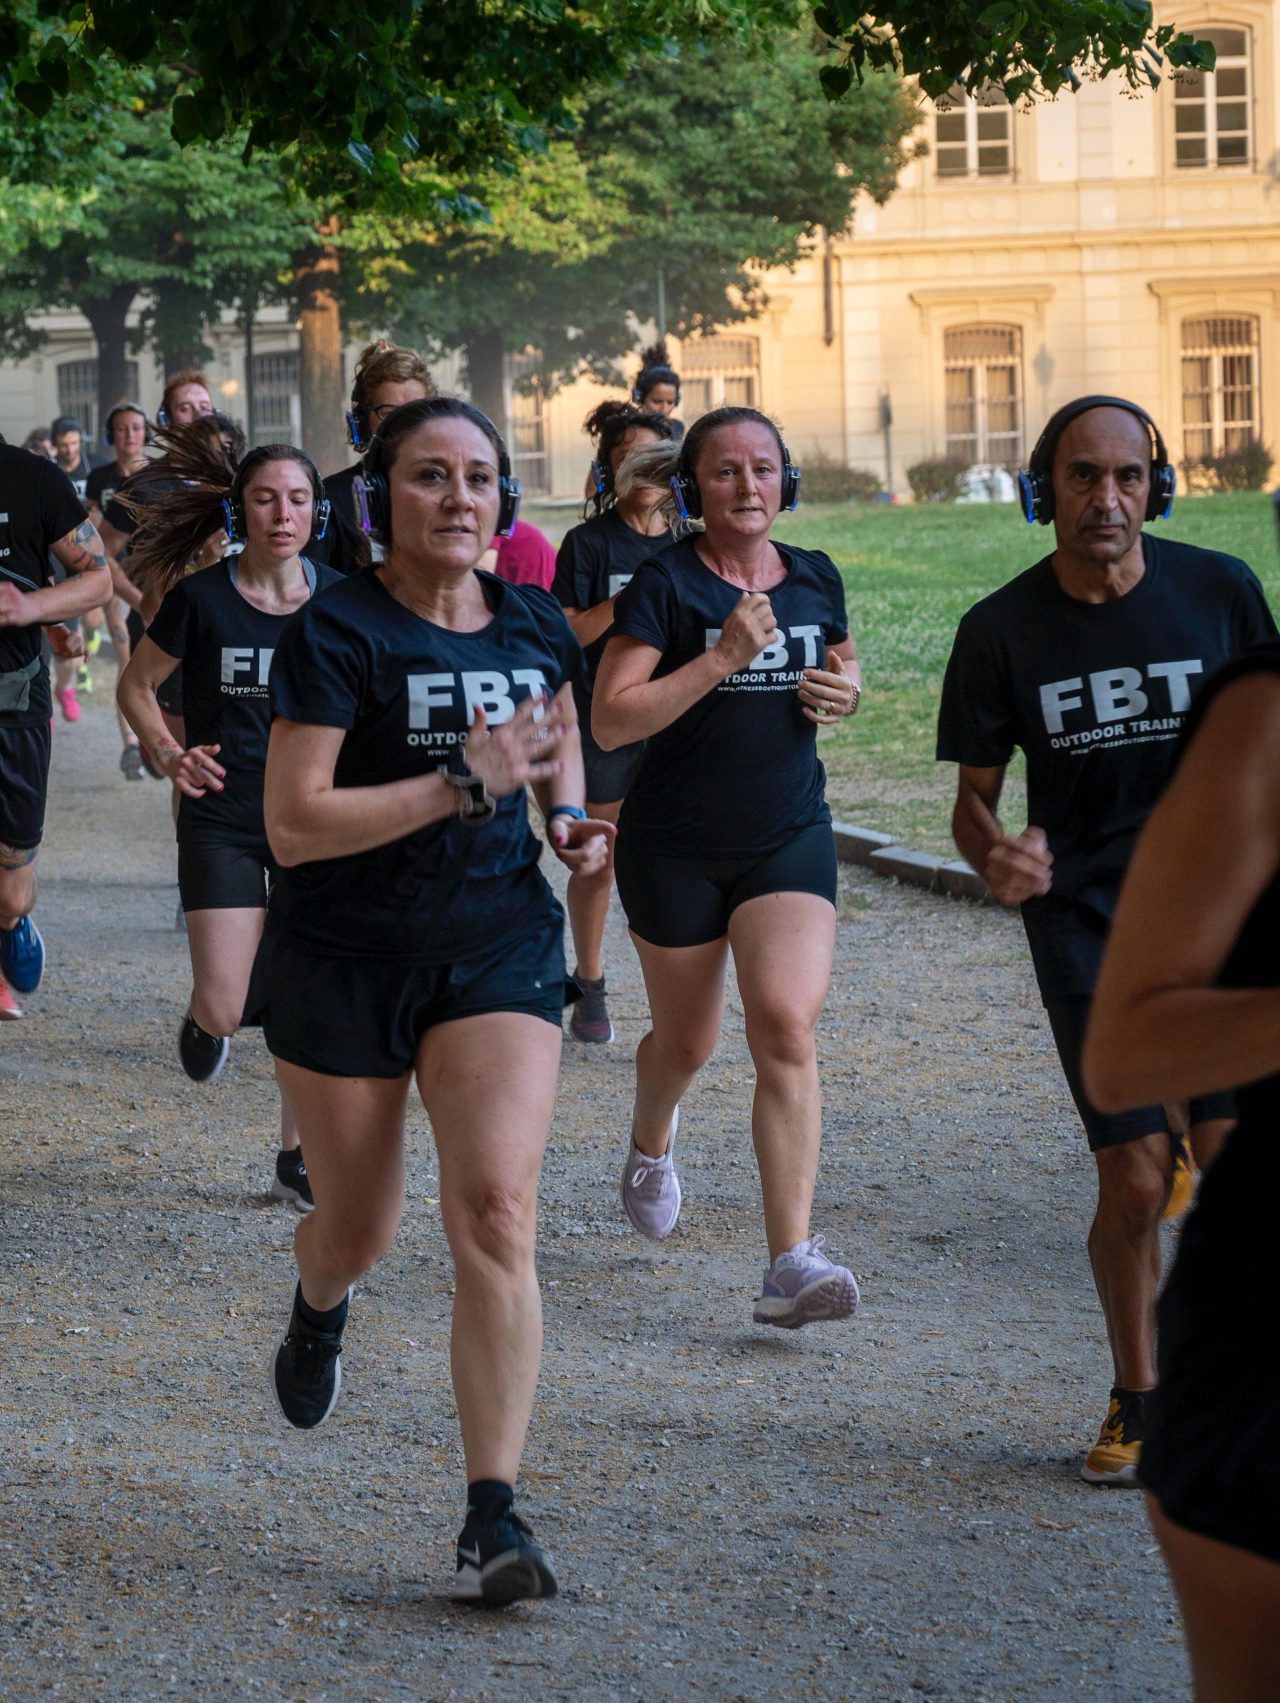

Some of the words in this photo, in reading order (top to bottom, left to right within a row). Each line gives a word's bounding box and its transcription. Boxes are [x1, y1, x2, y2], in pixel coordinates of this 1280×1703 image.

[725, 672, 766, 684] TDOOR
[771, 670, 811, 683] TRAIN
[220, 685, 268, 696] OUTDOO
[407, 669, 548, 729] FBT
[1039, 659, 1203, 734] FBT
[407, 731, 491, 746] OUTDO
[1050, 724, 1126, 749] OUTDOOR
[1130, 716, 1187, 733] TRAIN
